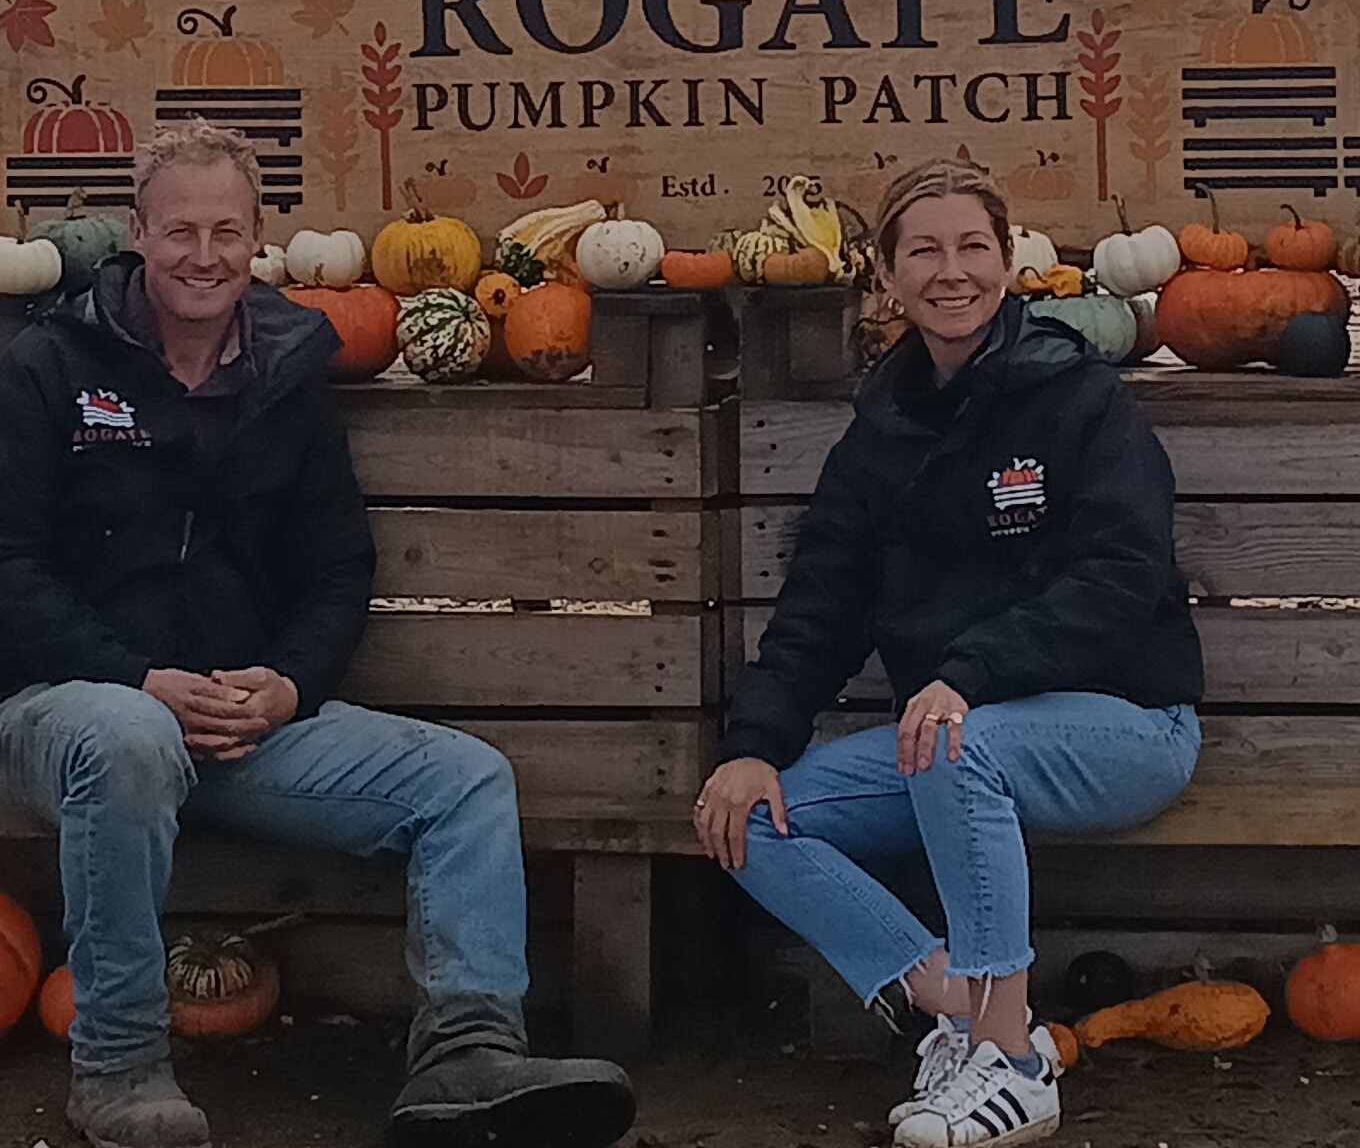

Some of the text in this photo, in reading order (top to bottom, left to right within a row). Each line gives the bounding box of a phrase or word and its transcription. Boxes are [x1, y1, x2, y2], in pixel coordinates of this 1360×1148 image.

[411, 71, 1074, 132] PUMPKIN PATCH
[762, 174, 824, 198] 205
